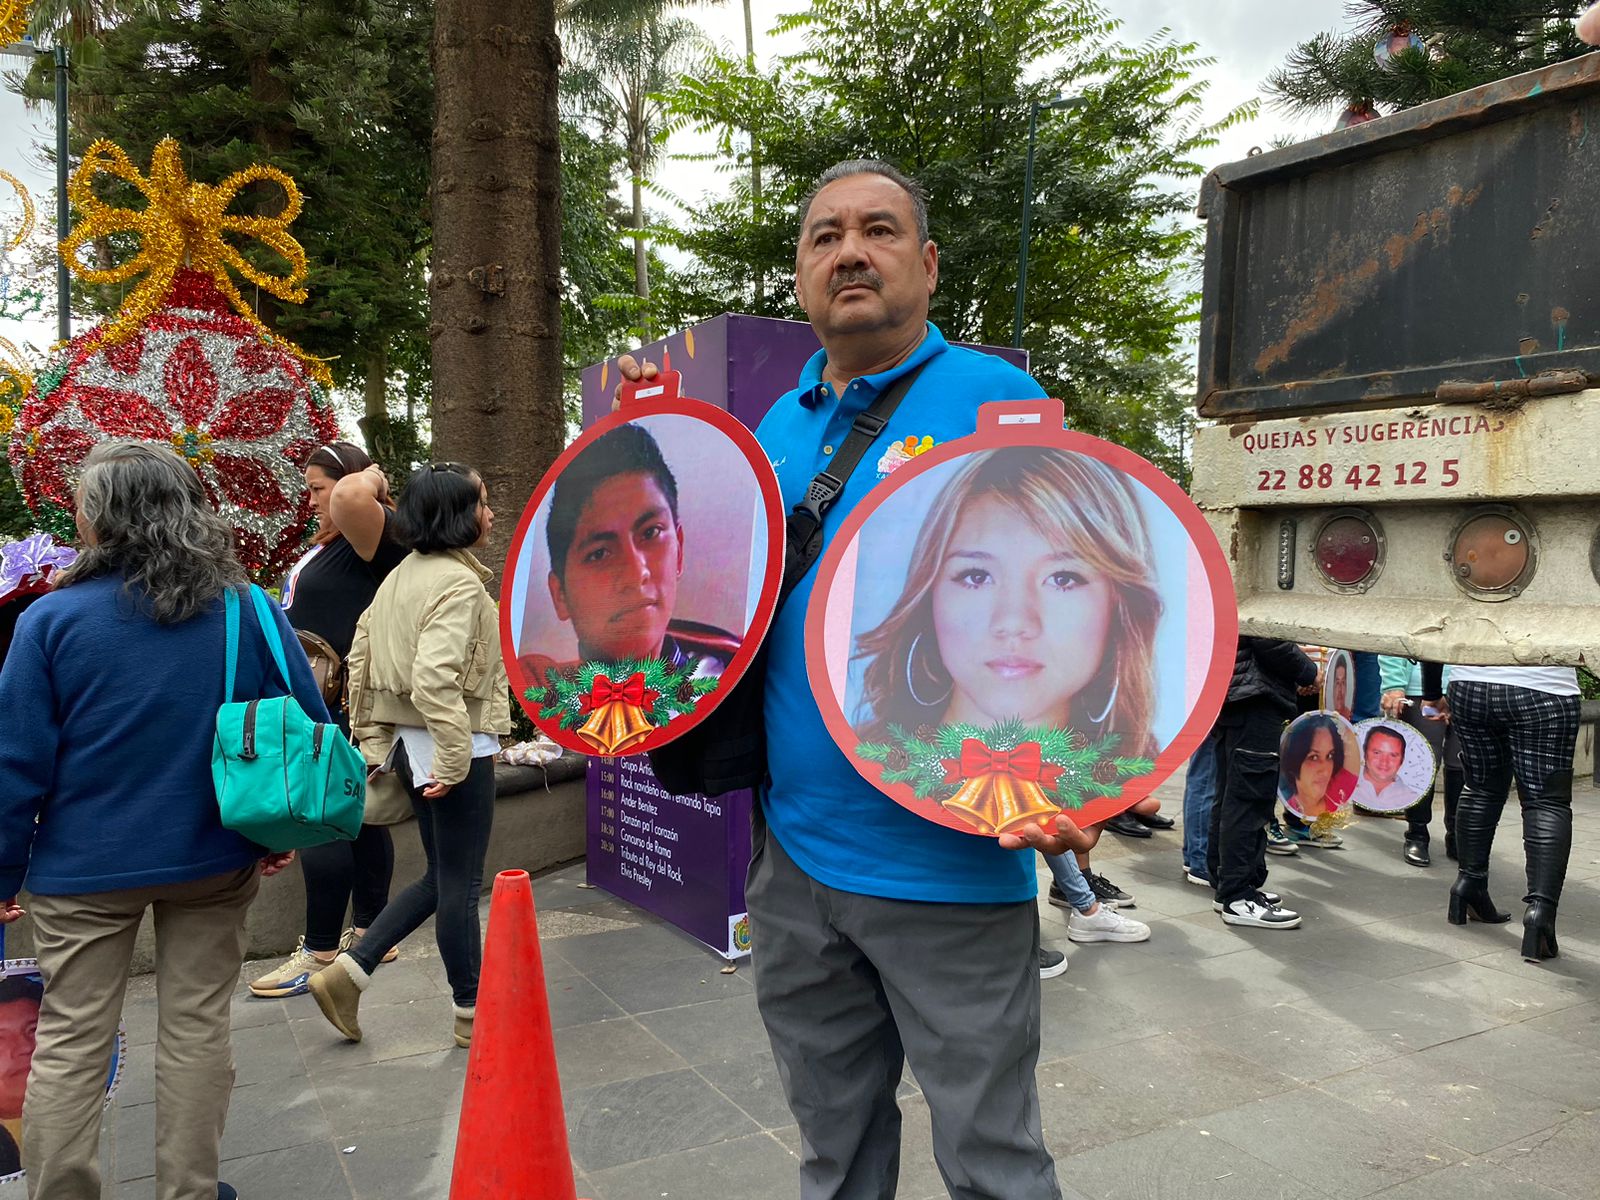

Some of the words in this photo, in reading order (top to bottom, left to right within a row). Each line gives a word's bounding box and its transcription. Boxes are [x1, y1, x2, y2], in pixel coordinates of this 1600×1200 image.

[1243, 429, 1317, 454] QUEJAS
[1325, 426, 1336, 445] Y
[1257, 469, 1286, 490] 22
[1297, 463, 1333, 489] 88
[1345, 464, 1381, 490] 42
[1394, 461, 1427, 485] 12
[1441, 459, 1460, 487] 5
[620, 756, 638, 774] Grupo
[601, 771, 615, 783] 15:00
[620, 774, 633, 789] Rock
[634, 780, 660, 797] navideño
[703, 797, 721, 818] Tapia
[620, 792, 637, 808] Ander
[601, 805, 615, 819] 17:00
[620, 810, 642, 829] Danzón
[654, 827, 679, 842] corazón
[620, 828, 645, 848] Concurso
[645, 836, 653, 851] de
[654, 840, 672, 859] Rama
[620, 845, 638, 863] Tributo
[638, 852, 644, 866] al
[645, 855, 656, 874] Rey
[656, 859, 667, 875] del
[667, 864, 684, 886] Rock,
[620, 862, 633, 878] Elvis
[632, 868, 653, 891] Presley
